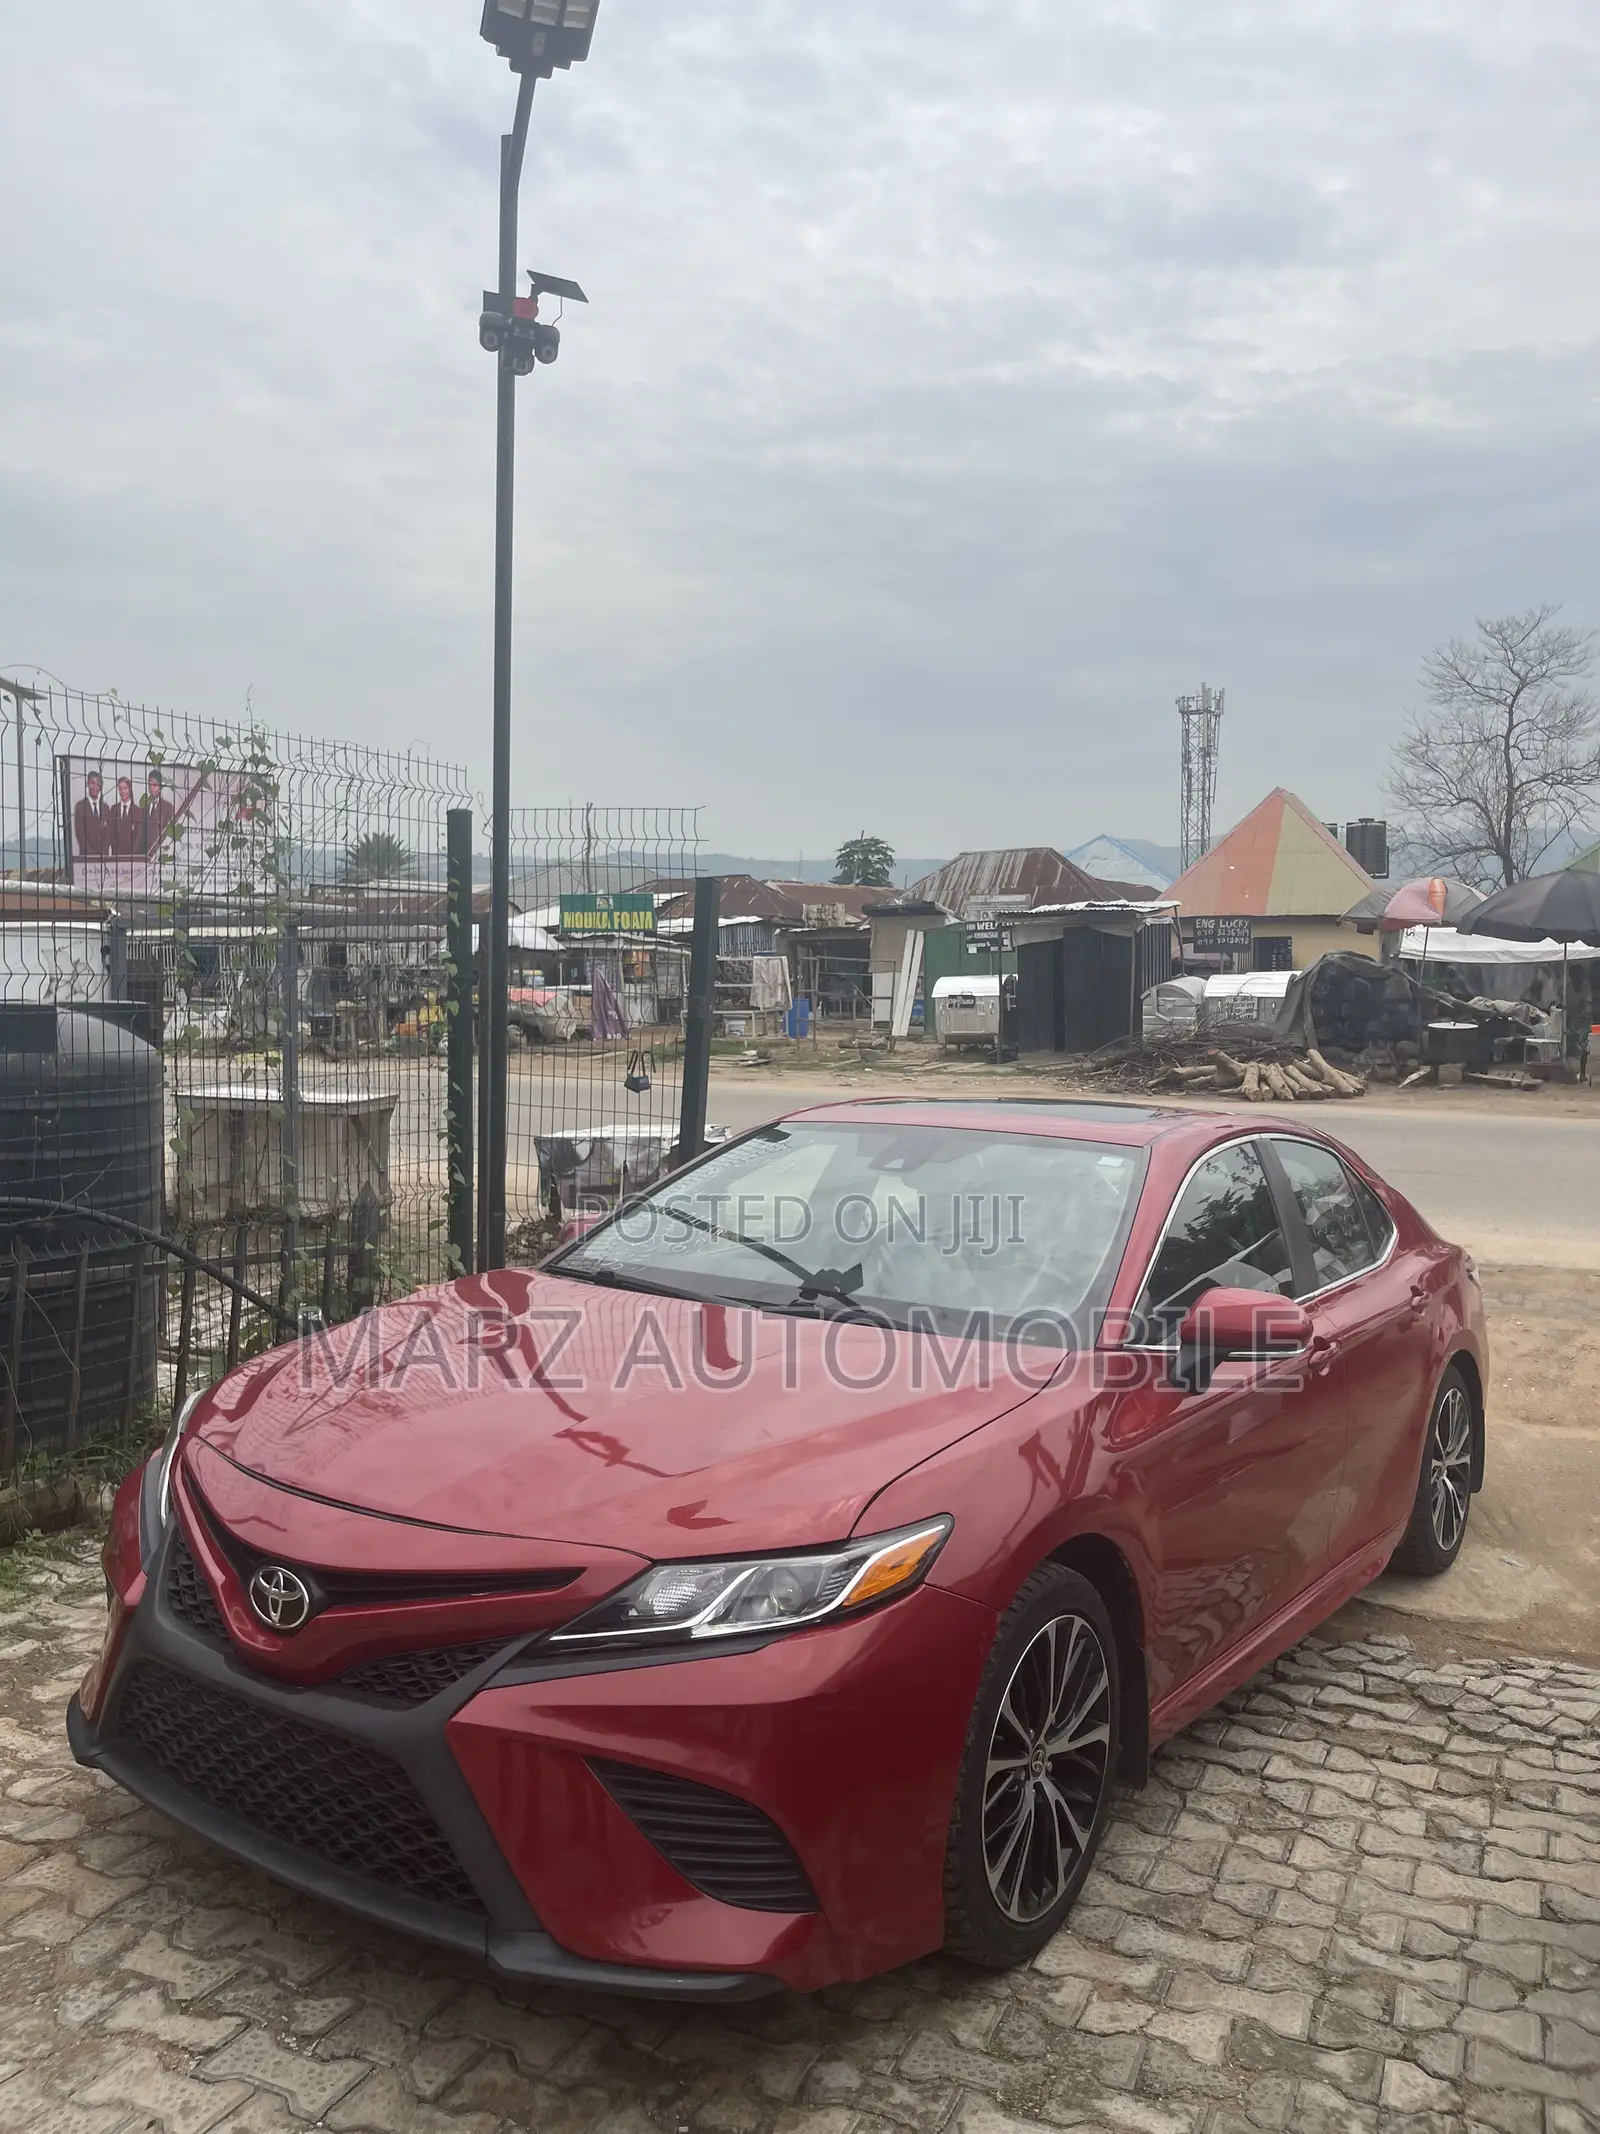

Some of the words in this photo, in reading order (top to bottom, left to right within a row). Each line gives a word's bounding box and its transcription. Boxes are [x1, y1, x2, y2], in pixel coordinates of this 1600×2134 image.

[613, 911, 653, 930] FOAM
[1195, 918, 1216, 929] ENG
[1219, 918, 1250, 929] LUCKY
